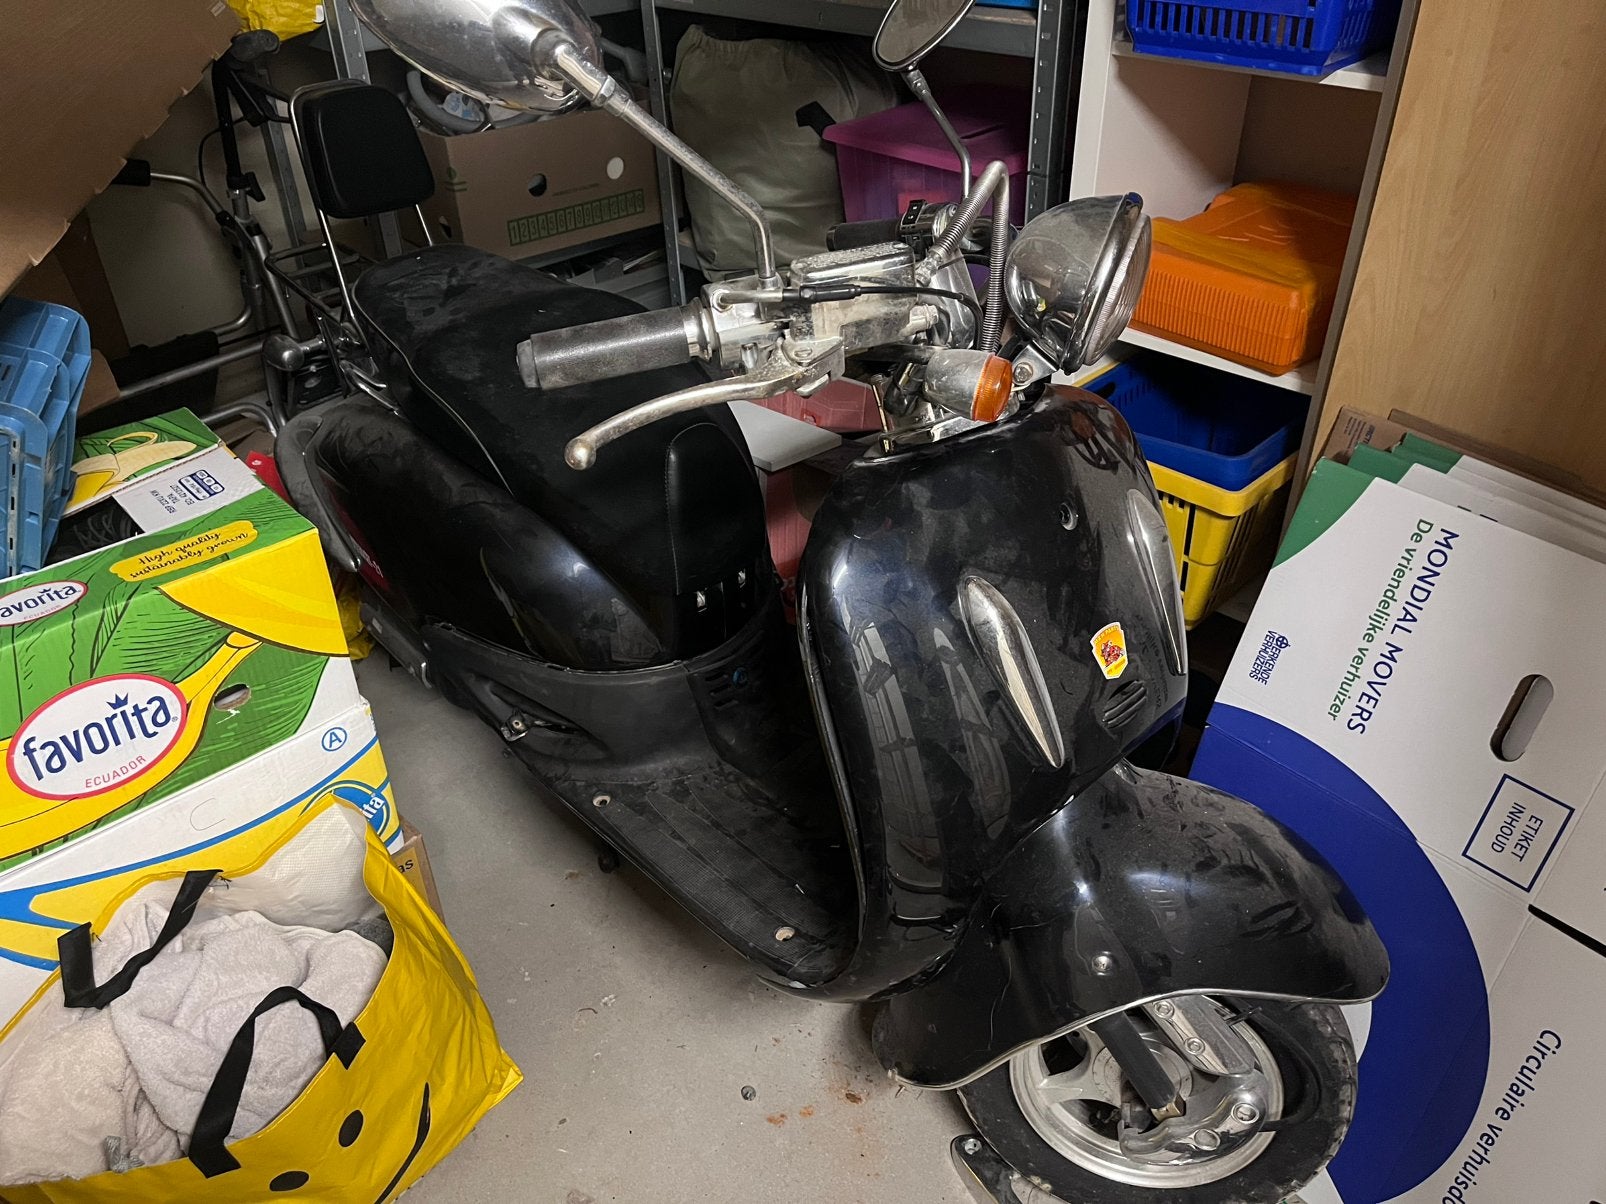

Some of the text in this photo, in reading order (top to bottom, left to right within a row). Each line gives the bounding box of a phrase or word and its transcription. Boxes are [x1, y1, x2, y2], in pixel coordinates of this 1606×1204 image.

[130, 532, 248, 578] sustainably grown
[138, 532, 221, 565] High quality
[0, 585, 77, 618] avorita
[1328, 518, 1435, 721] De vriendelijke verhuizer
[1347, 528, 1460, 735] MONDIAL MOVERS
[1249, 630, 1278, 680] VERHUIZERS
[1257, 645, 1281, 686] ERKENDE
[23, 693, 171, 782] favorita
[327, 730, 342, 746] A
[85, 755, 147, 789] ECUADOR
[362, 796, 385, 819] ita
[1490, 802, 1526, 854] INHOUD
[1511, 815, 1543, 863] ETIKET
[398, 859, 414, 873] as
[1494, 1029, 1562, 1121] Circulaire
